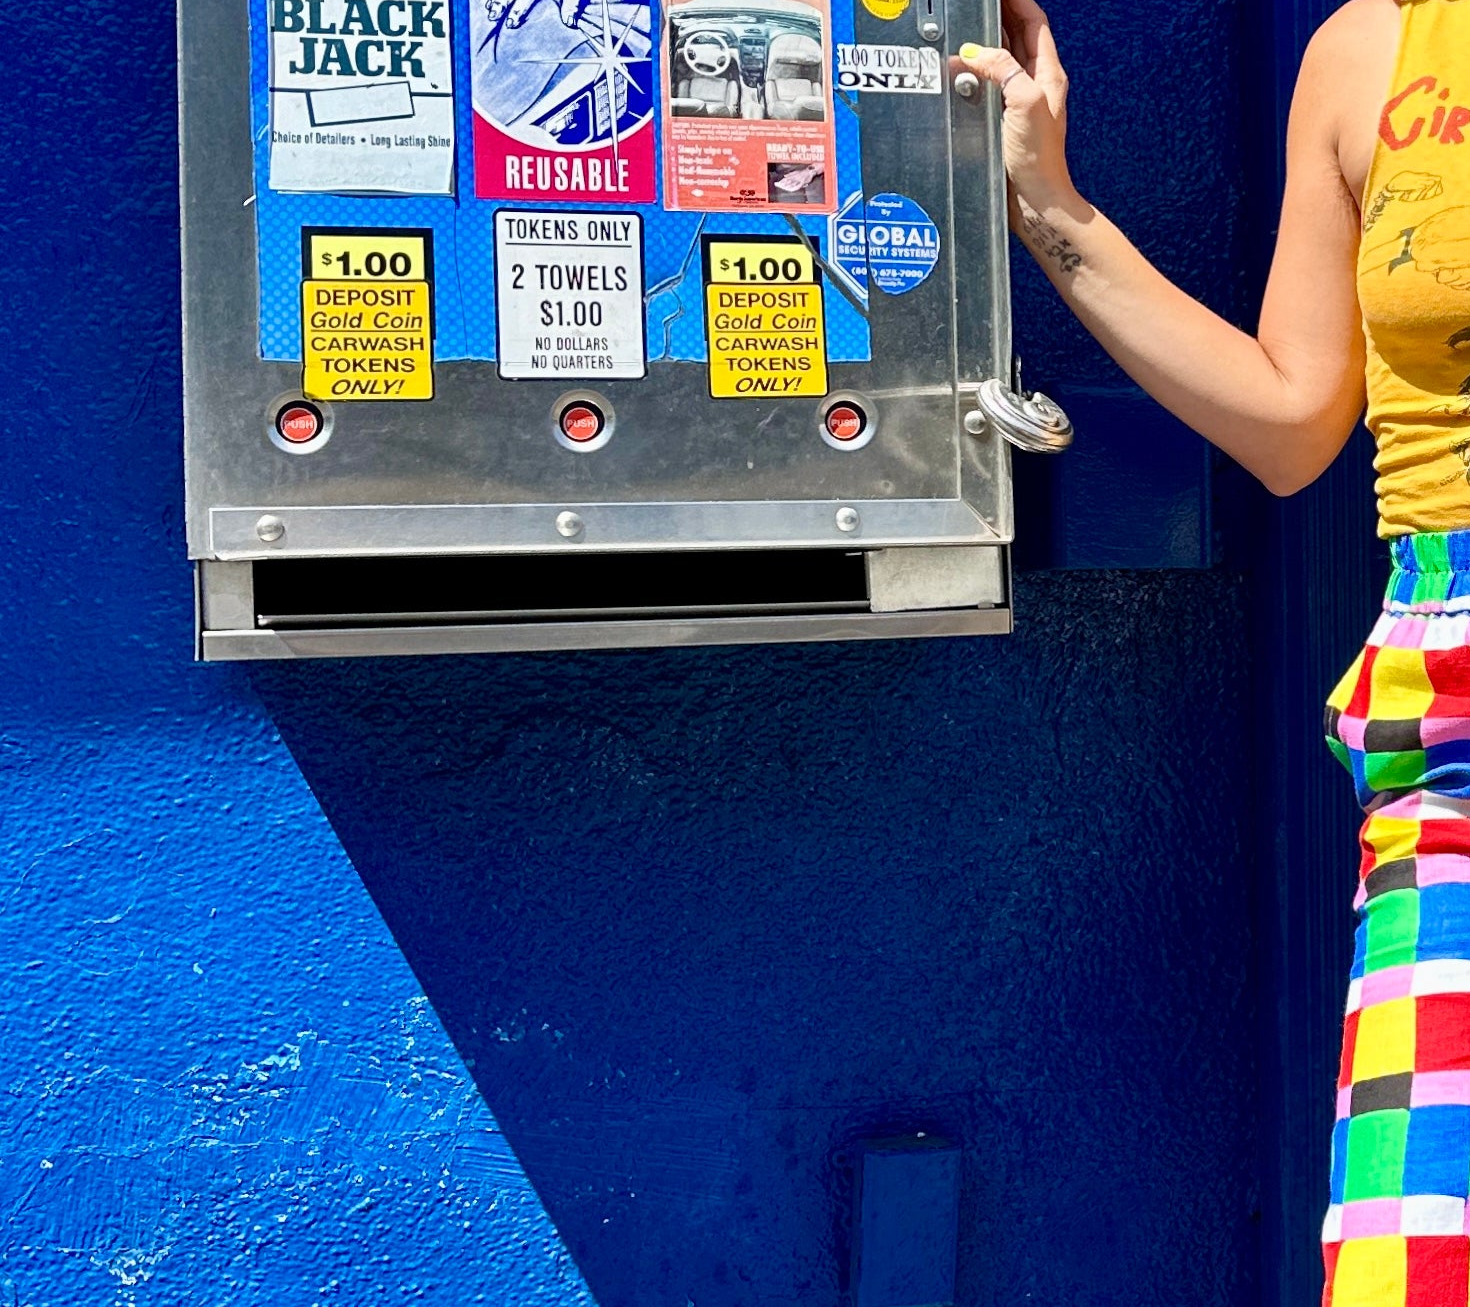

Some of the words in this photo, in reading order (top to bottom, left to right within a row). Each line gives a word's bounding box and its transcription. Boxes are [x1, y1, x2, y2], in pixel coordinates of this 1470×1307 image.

[288, 36, 426, 79] JACK
[873, 48, 939, 70] TOKENS
[838, 71, 938, 89] ONLY
[271, 130, 302, 144] Choice
[304, 131, 313, 145] of
[315, 131, 356, 147] Detailers
[370, 133, 392, 150] Long
[394, 134, 426, 150] Lasting
[427, 134, 451, 149] Shine
[505, 154, 630, 193] REUSABLE
[504, 217, 579, 241] TOKENS
[587, 220, 632, 242] ONLY
[837, 224, 936, 248] GLOBAL
[890, 247, 938, 259] SYSTEMS
[321, 250, 412, 277] $1.00
[719, 256, 802, 282] $1.00
[511, 263, 525, 290] 2
[534, 264, 628, 292] TOWELS
[315, 288, 416, 307] DEPOSIT
[718, 291, 810, 309] DEPOSIT
[310, 311, 364, 329] Gold
[372, 311, 424, 329] Coin
[539, 299, 603, 328] $1.00
[714, 312, 763, 330] Gold
[771, 313, 817, 330] Coin
[310, 336, 425, 352] CARWASH
[535, 336, 551, 351] NO
[556, 336, 609, 352] DOLLARS
[714, 336, 819, 352] CARWASH
[320, 357, 416, 373] TOKENS
[531, 354, 547, 370] NO
[552, 354, 614, 371] QUARTERS
[724, 356, 812, 372] TOKENS
[330, 378, 406, 396] ONLY!
[734, 376, 803, 393] ONLY!
[566, 418, 595, 429] PUSH
